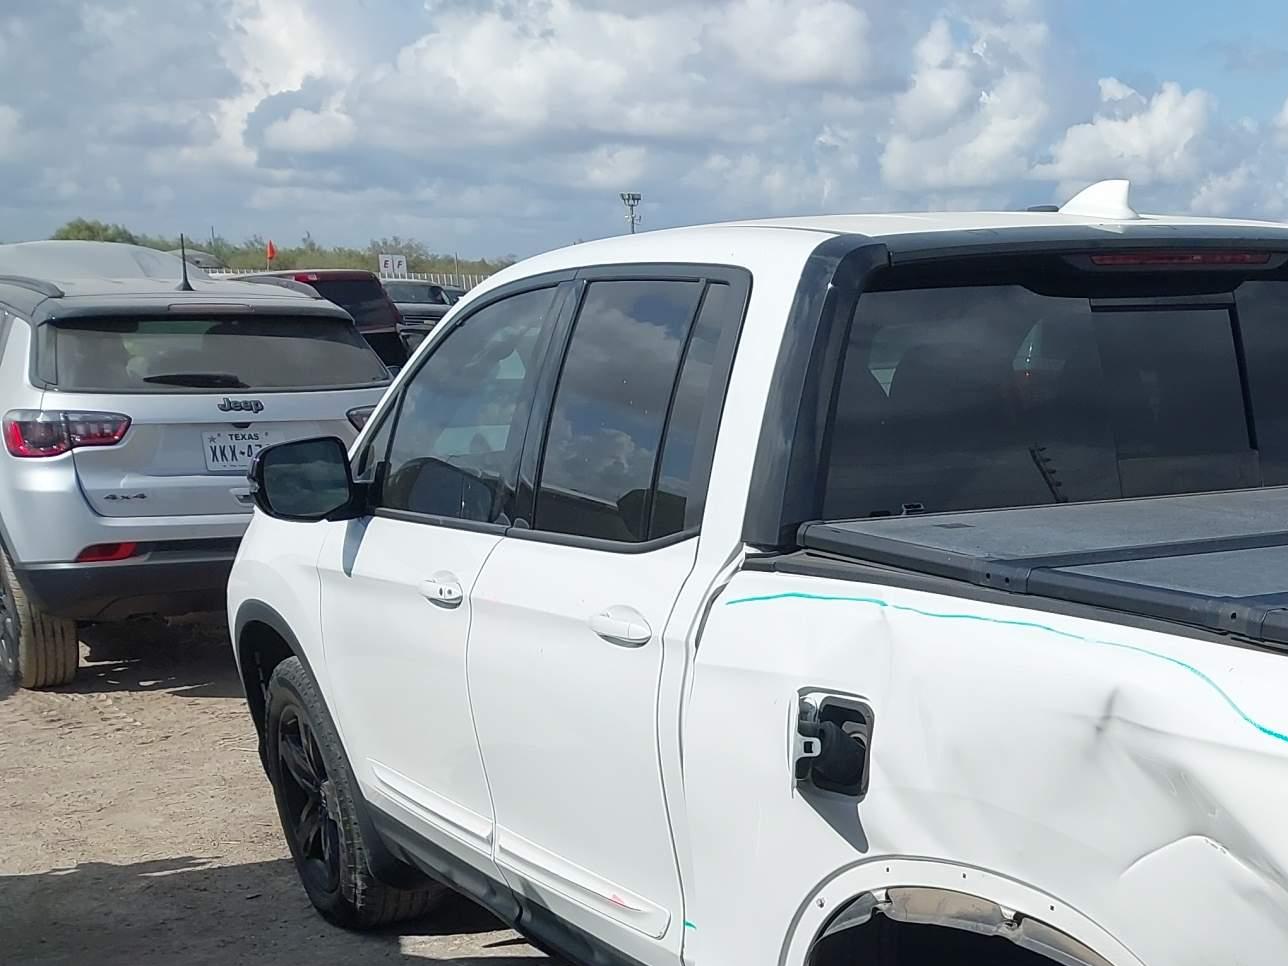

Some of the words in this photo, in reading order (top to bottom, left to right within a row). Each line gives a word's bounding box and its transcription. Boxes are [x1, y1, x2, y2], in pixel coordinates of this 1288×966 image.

[383, 259, 390, 269] E
[397, 260, 403, 269] F
[217, 397, 264, 414] Jeep
[228, 433, 260, 441] TEXAS
[210, 443, 270, 463] XKX-0
